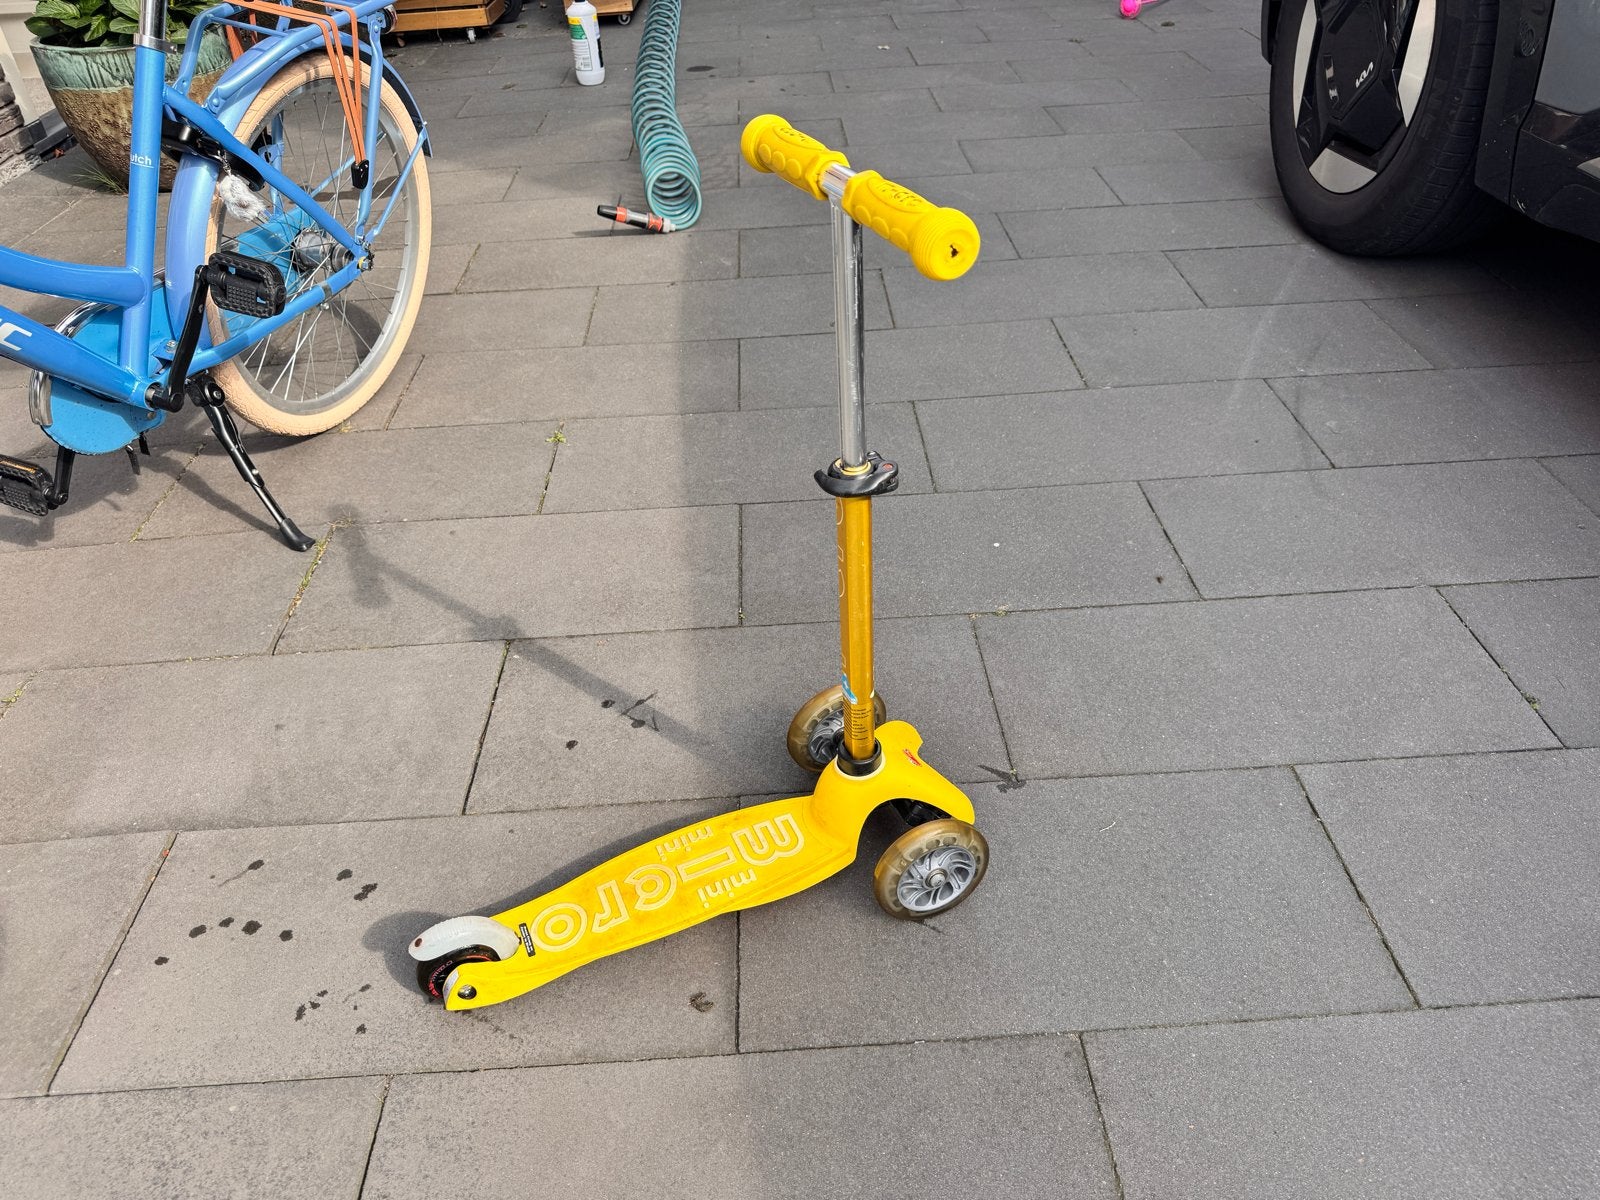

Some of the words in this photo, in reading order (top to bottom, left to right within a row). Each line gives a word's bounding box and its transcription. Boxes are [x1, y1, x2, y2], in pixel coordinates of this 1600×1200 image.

[131, 153, 152, 166] utch
[655, 826, 714, 862] mini
[531, 812, 805, 953] micro
[696, 868, 758, 909] mini
